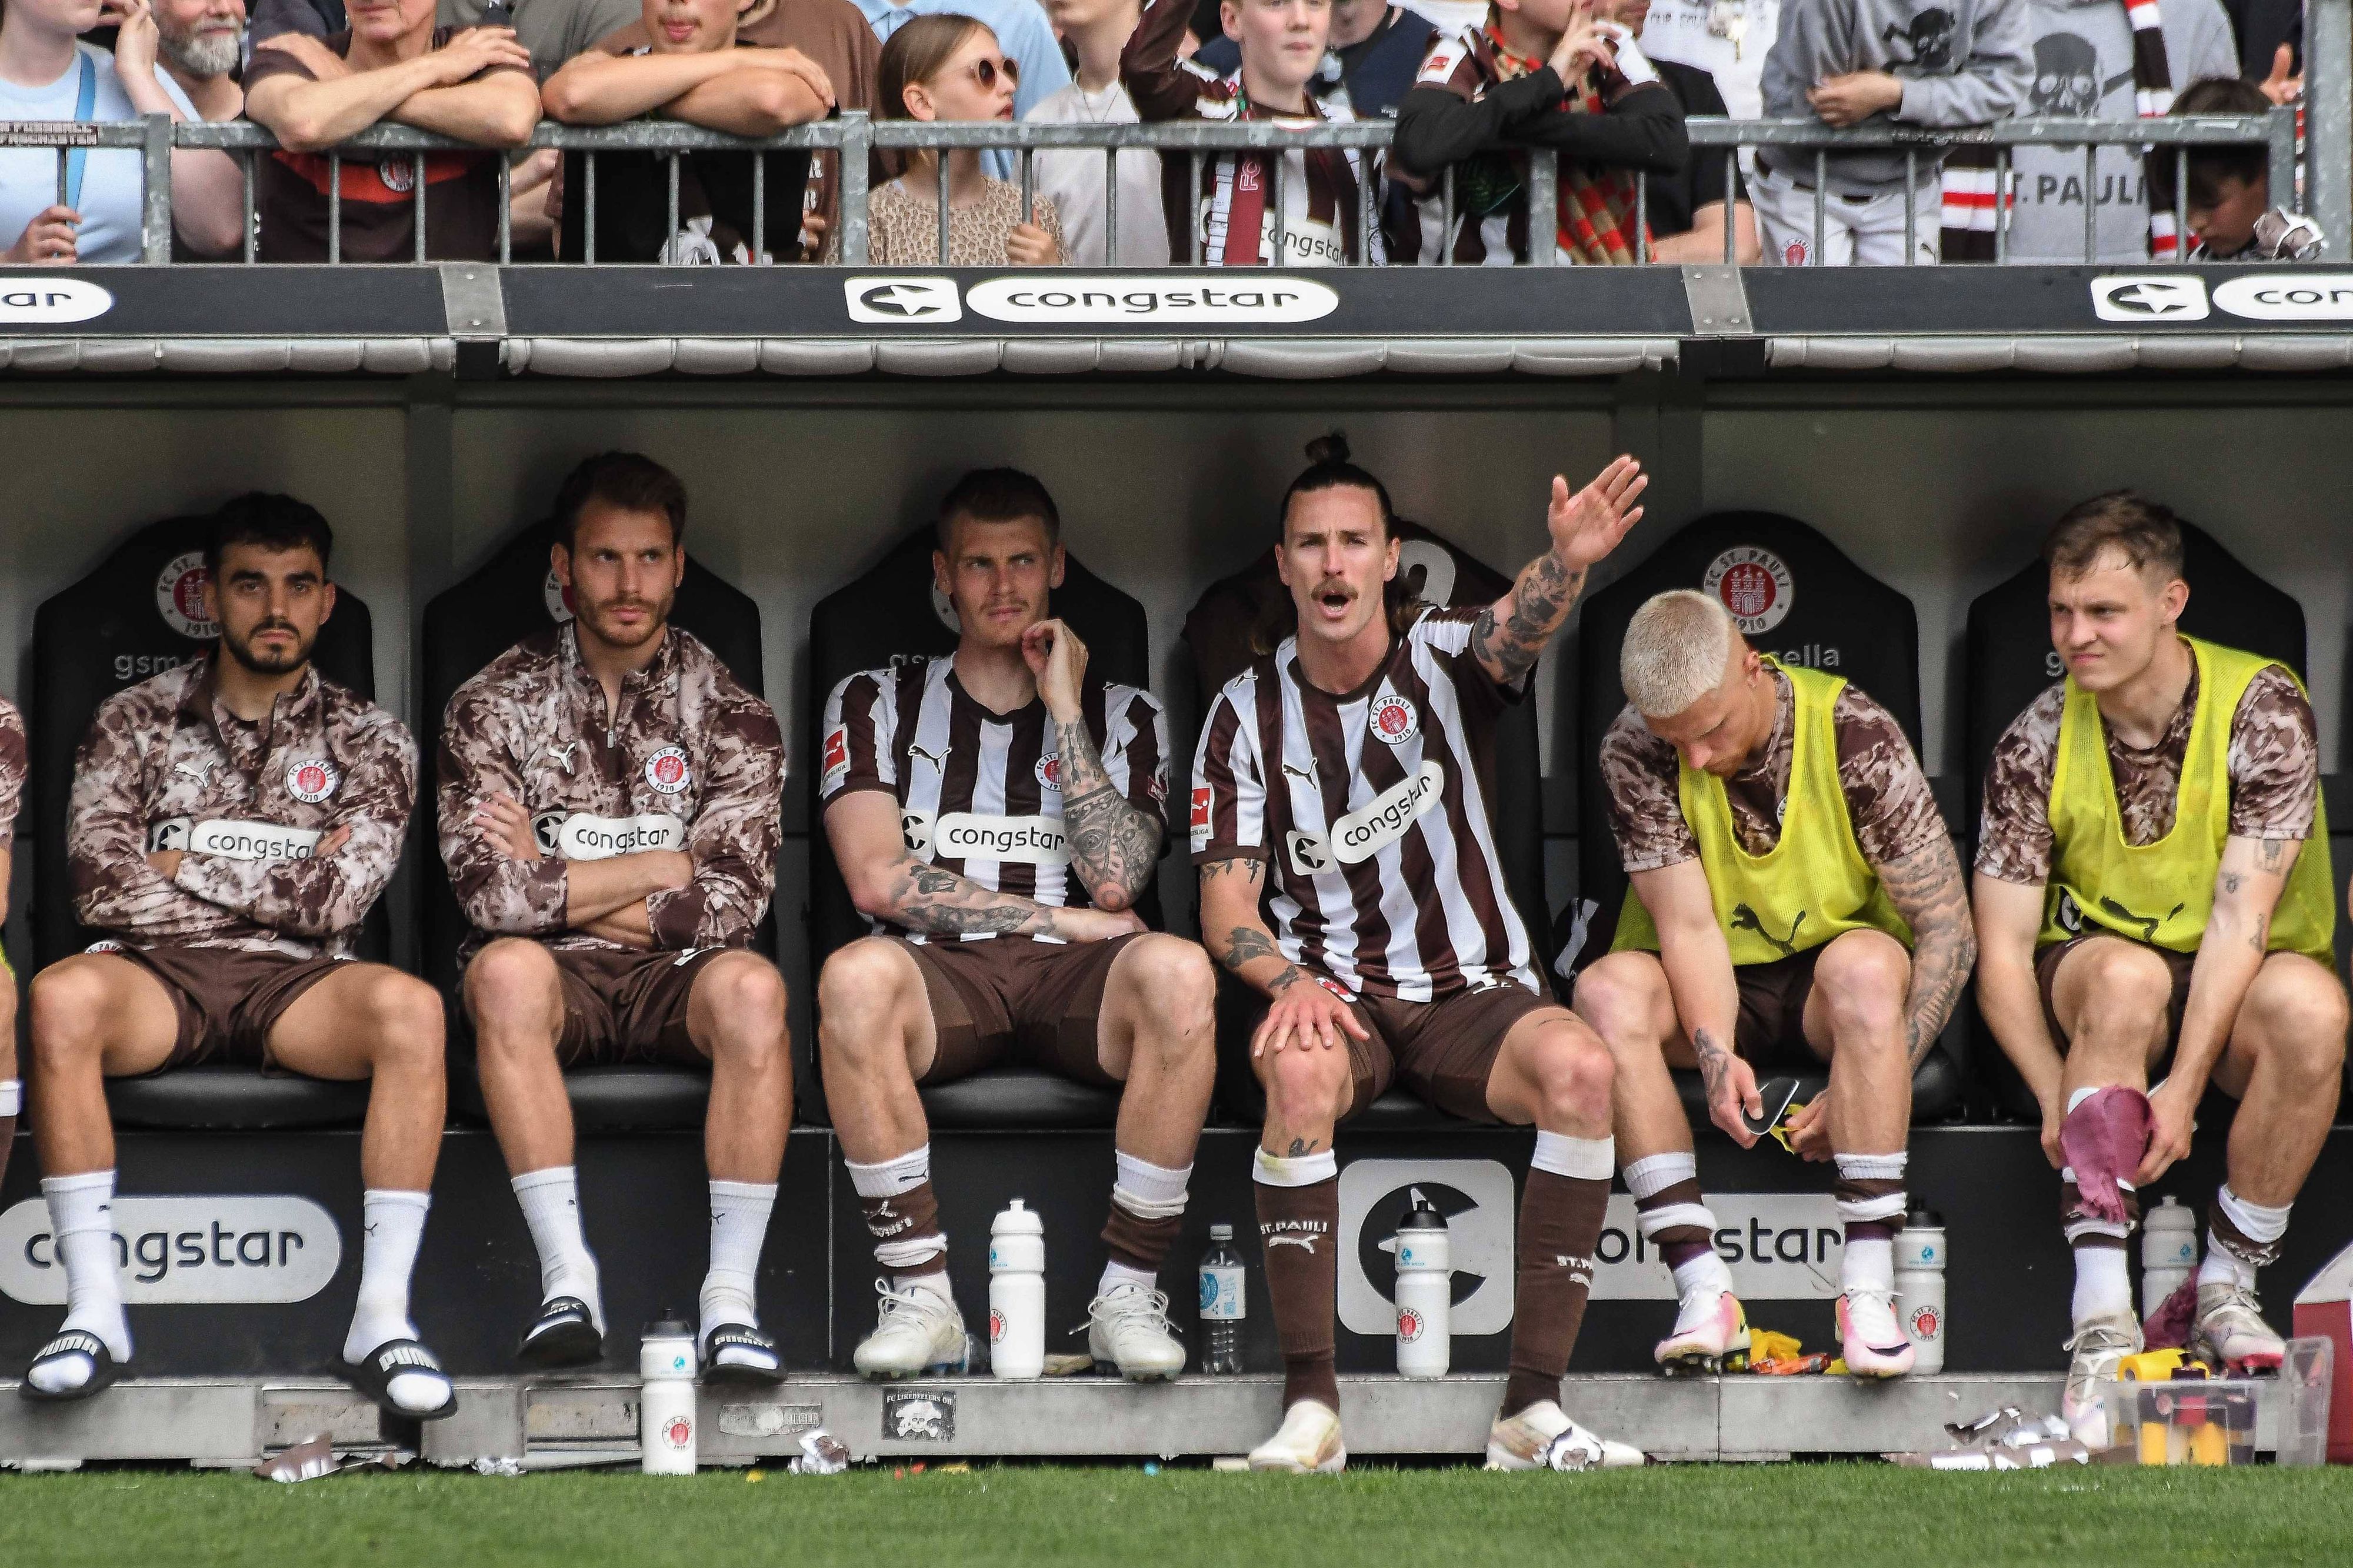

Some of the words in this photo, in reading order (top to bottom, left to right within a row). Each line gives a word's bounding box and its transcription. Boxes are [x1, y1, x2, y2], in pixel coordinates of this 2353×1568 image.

[1006, 288, 1299, 313] congstar
[1733, 617, 1767, 632] 910
[1382, 698, 1411, 710] PAULI
[1372, 706, 1382, 717] ST.
[1371, 720, 1379, 730] FC
[1394, 728, 1411, 742] 1910
[299, 793, 319, 802] 1910
[575, 826, 669, 855] congstar
[949, 826, 1065, 852] congstar
[886, 1394, 895, 1403] FC
